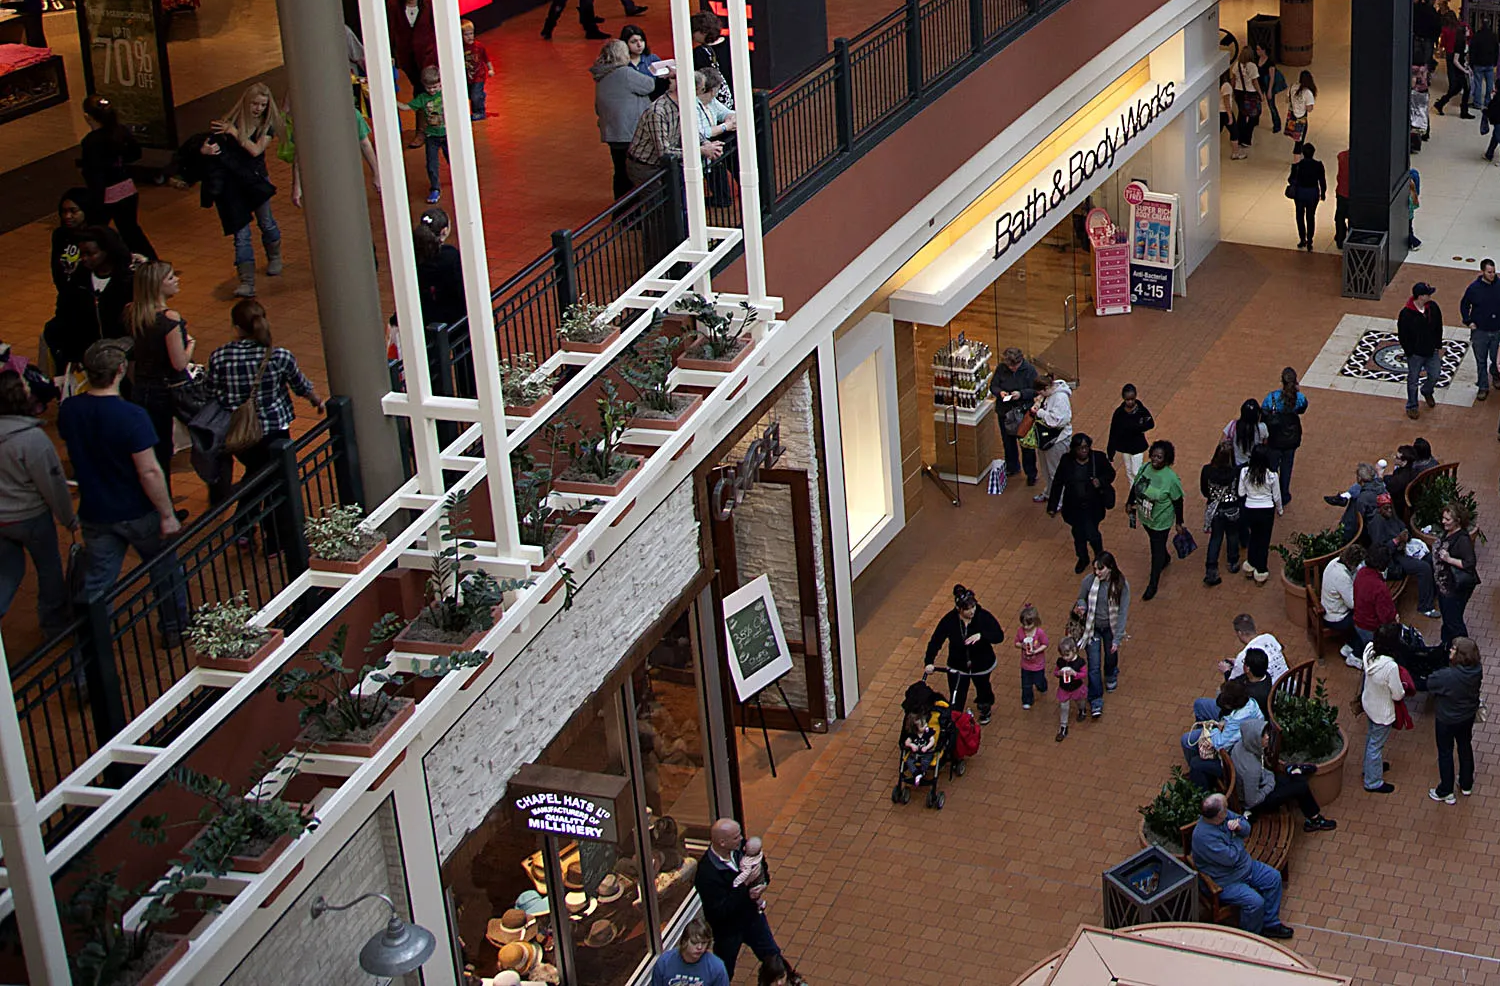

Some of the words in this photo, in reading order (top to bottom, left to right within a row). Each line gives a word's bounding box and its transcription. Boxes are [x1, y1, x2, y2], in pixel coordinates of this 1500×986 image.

[112, 27, 121, 39] UP
[122, 27, 131, 39] TO
[137, 74, 153, 89] OFF
[993, 188, 1047, 260] Bath
[1050, 169, 1067, 209] &
[1068, 127, 1119, 194] Body
[1121, 81, 1175, 145] Works
[1135, 205, 1156, 213] SUPER
[1133, 270, 1168, 281] Anti-Bacterial
[1134, 283, 1143, 295] 4
[516, 794, 562, 810] CHAPEL
[563, 795, 595, 813] HATS
[530, 806, 589, 821] MANUFACTURERS
[589, 816, 600, 825] OF
[544, 813, 587, 826] QUALITY
[528, 818, 604, 838] MILLINERY
